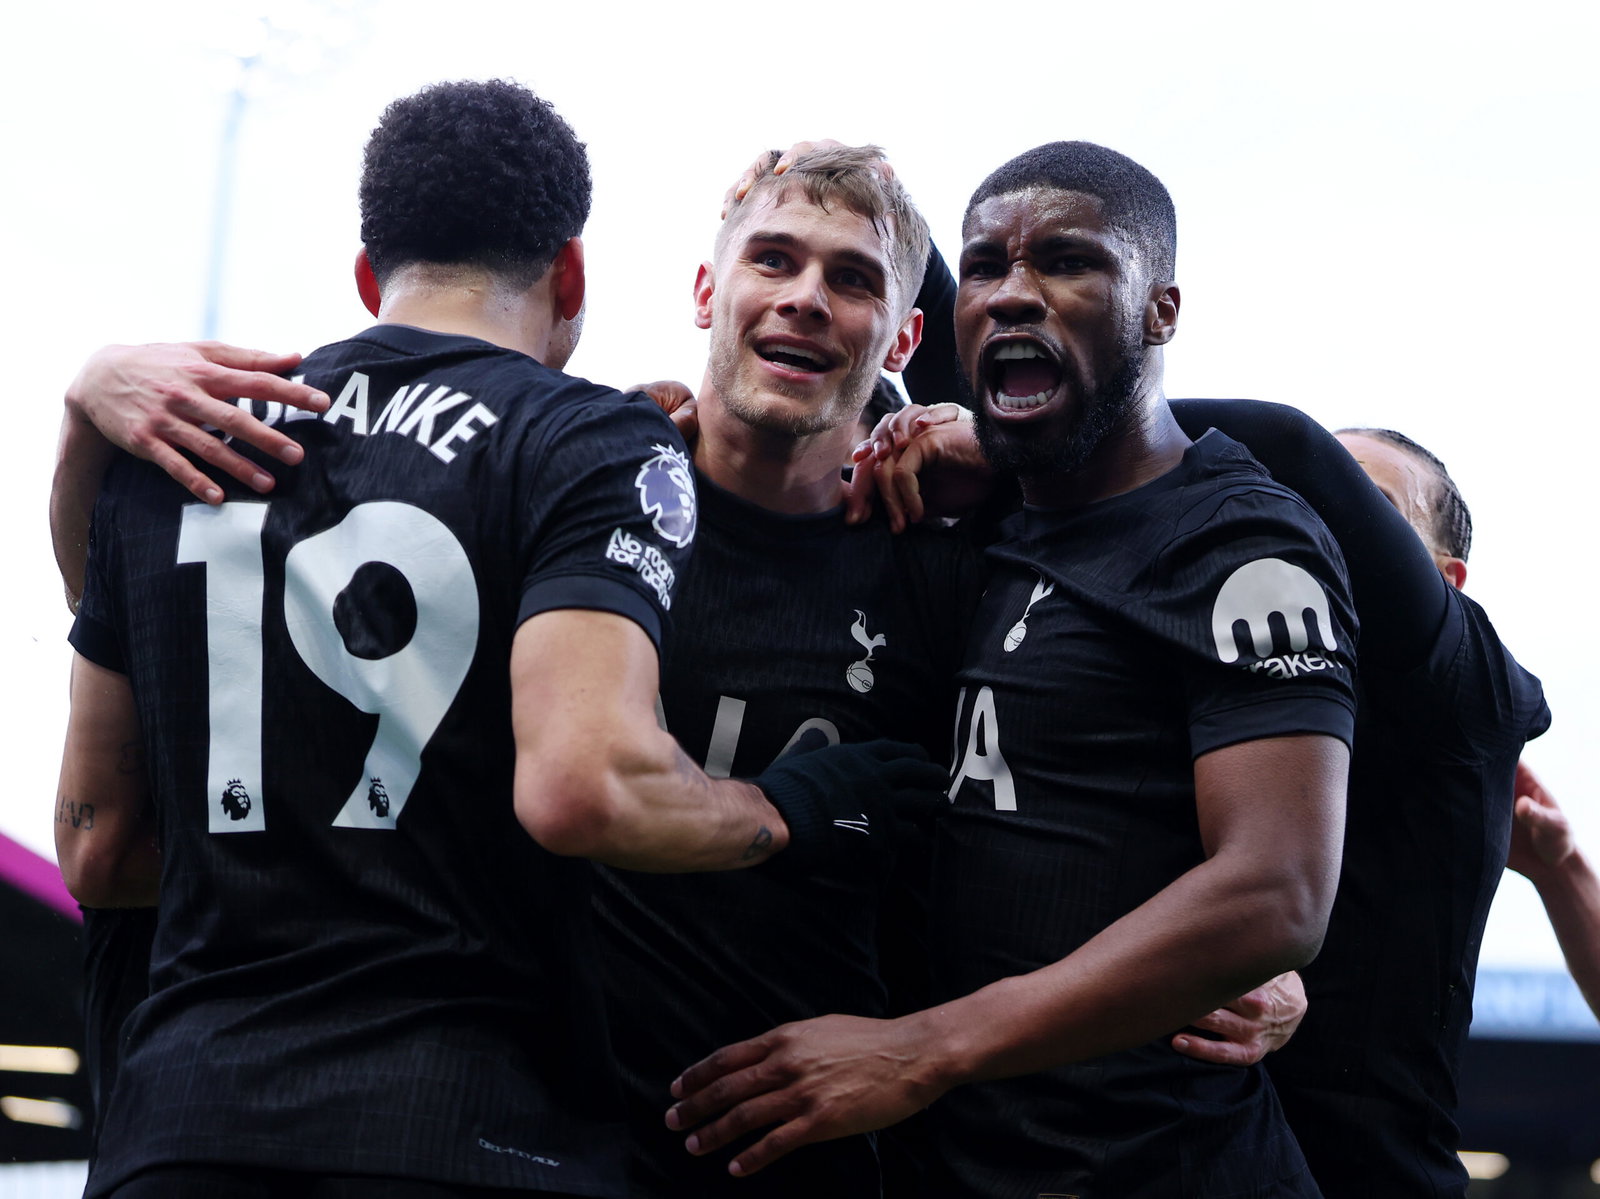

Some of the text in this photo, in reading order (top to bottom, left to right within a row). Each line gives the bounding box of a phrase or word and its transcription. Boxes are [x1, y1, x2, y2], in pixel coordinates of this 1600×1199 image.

[201, 371, 499, 464] LANKE
[177, 501, 479, 833] 19
[1243, 650, 1343, 680] raken
